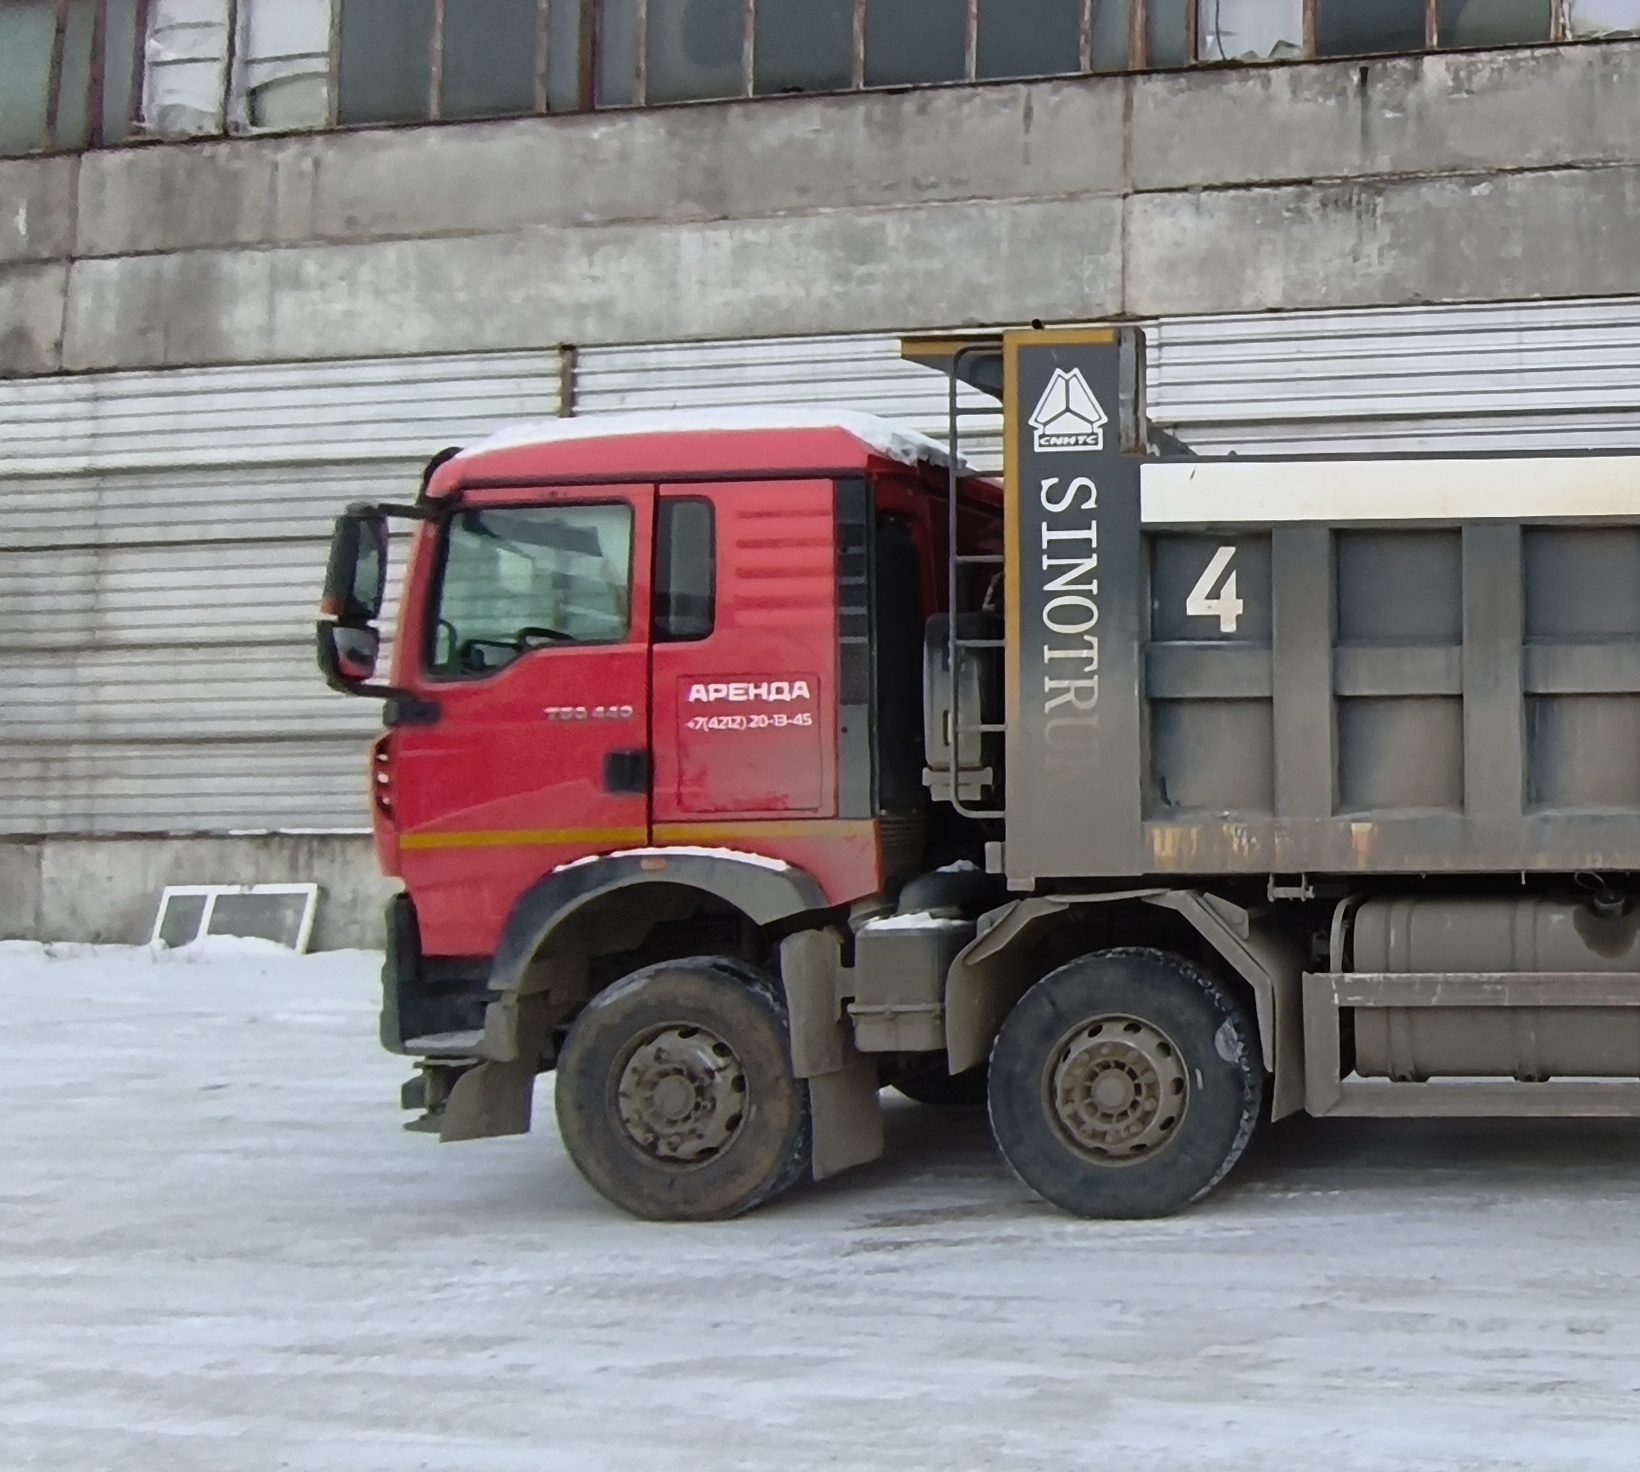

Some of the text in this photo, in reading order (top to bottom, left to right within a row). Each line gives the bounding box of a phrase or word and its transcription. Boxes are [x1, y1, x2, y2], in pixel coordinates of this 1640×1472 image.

[1039, 434, 1098, 446] CNHTC
[1185, 545, 1244, 634] 4
[1040, 476, 1099, 791] SINOTRU
[688, 680, 811, 703] АРЕНДА
[748, 712, 813, 729] 20-13-45
